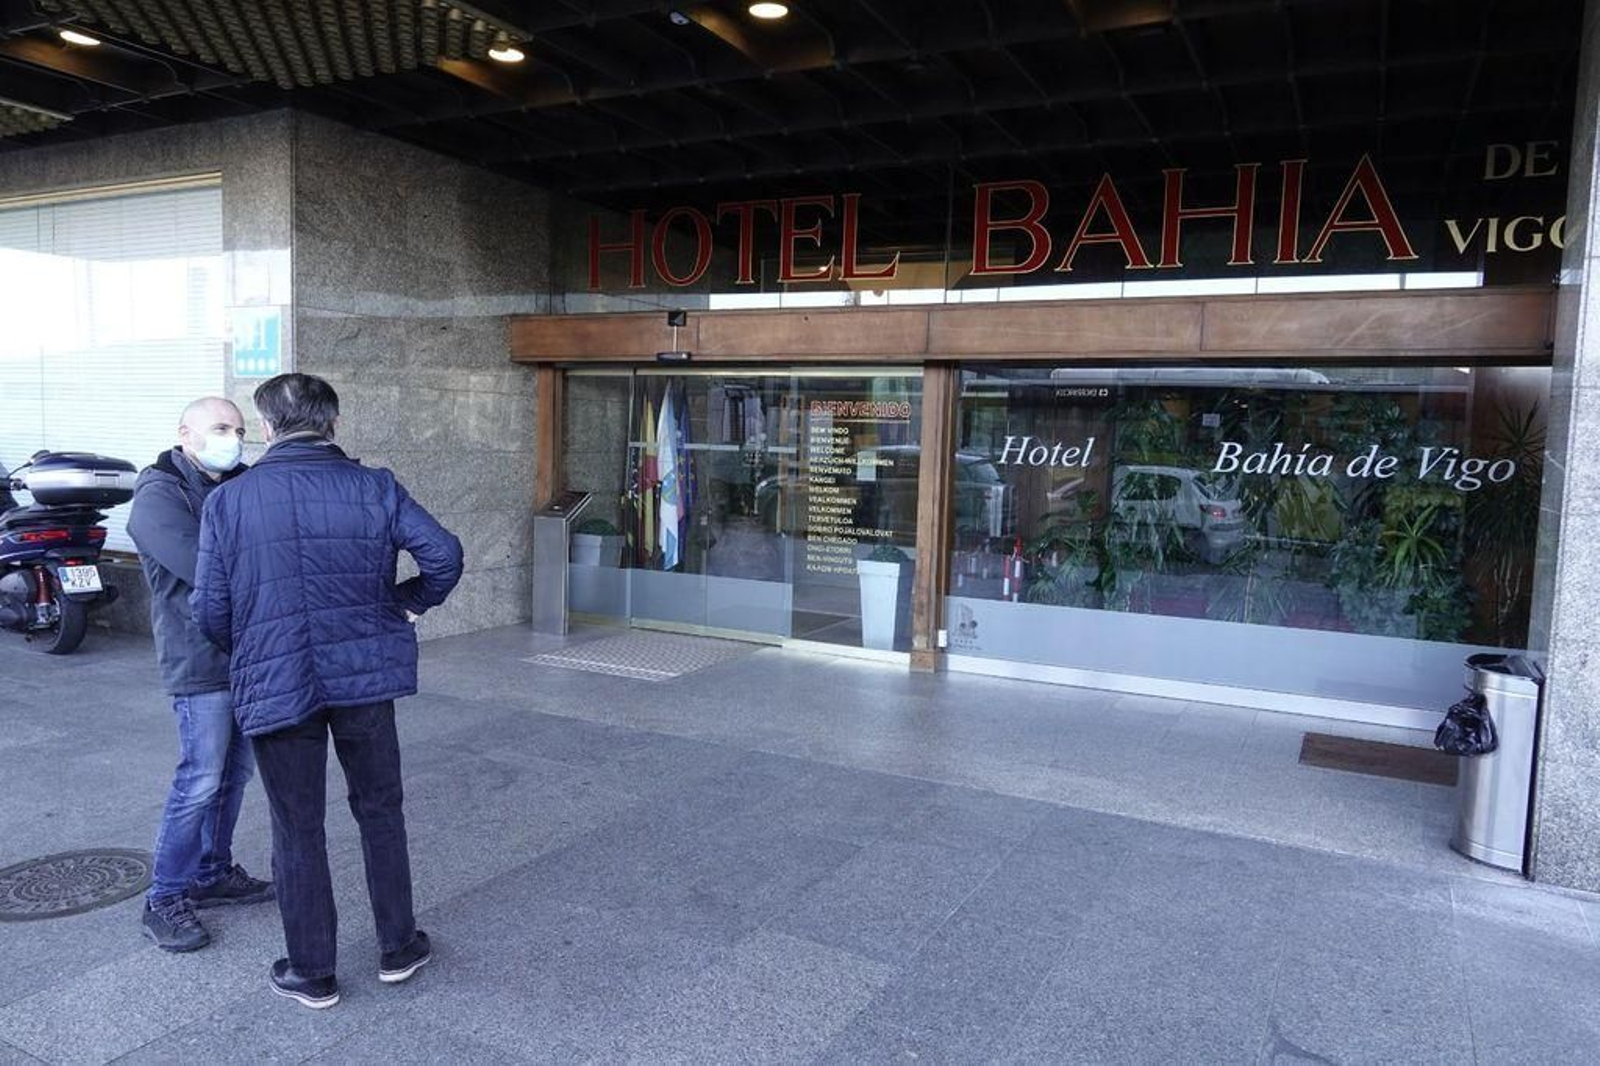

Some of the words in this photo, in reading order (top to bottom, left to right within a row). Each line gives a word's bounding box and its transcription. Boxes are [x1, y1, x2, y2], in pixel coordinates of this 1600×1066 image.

[1484, 140, 1560, 180] DE
[587, 193, 901, 290] HOTEL
[969, 153, 1420, 275] BAHIA
[810, 401, 912, 418] BIENVENIDO
[809, 446, 845, 455] WELCOME
[808, 466, 852, 475] BENVENUTO
[998, 435, 1096, 468] Hotel
[1211, 441, 1332, 477] Bahía
[1346, 445, 1399, 479] de
[1418, 446, 1516, 492] Vigo
[808, 485, 840, 494] WELKOM
